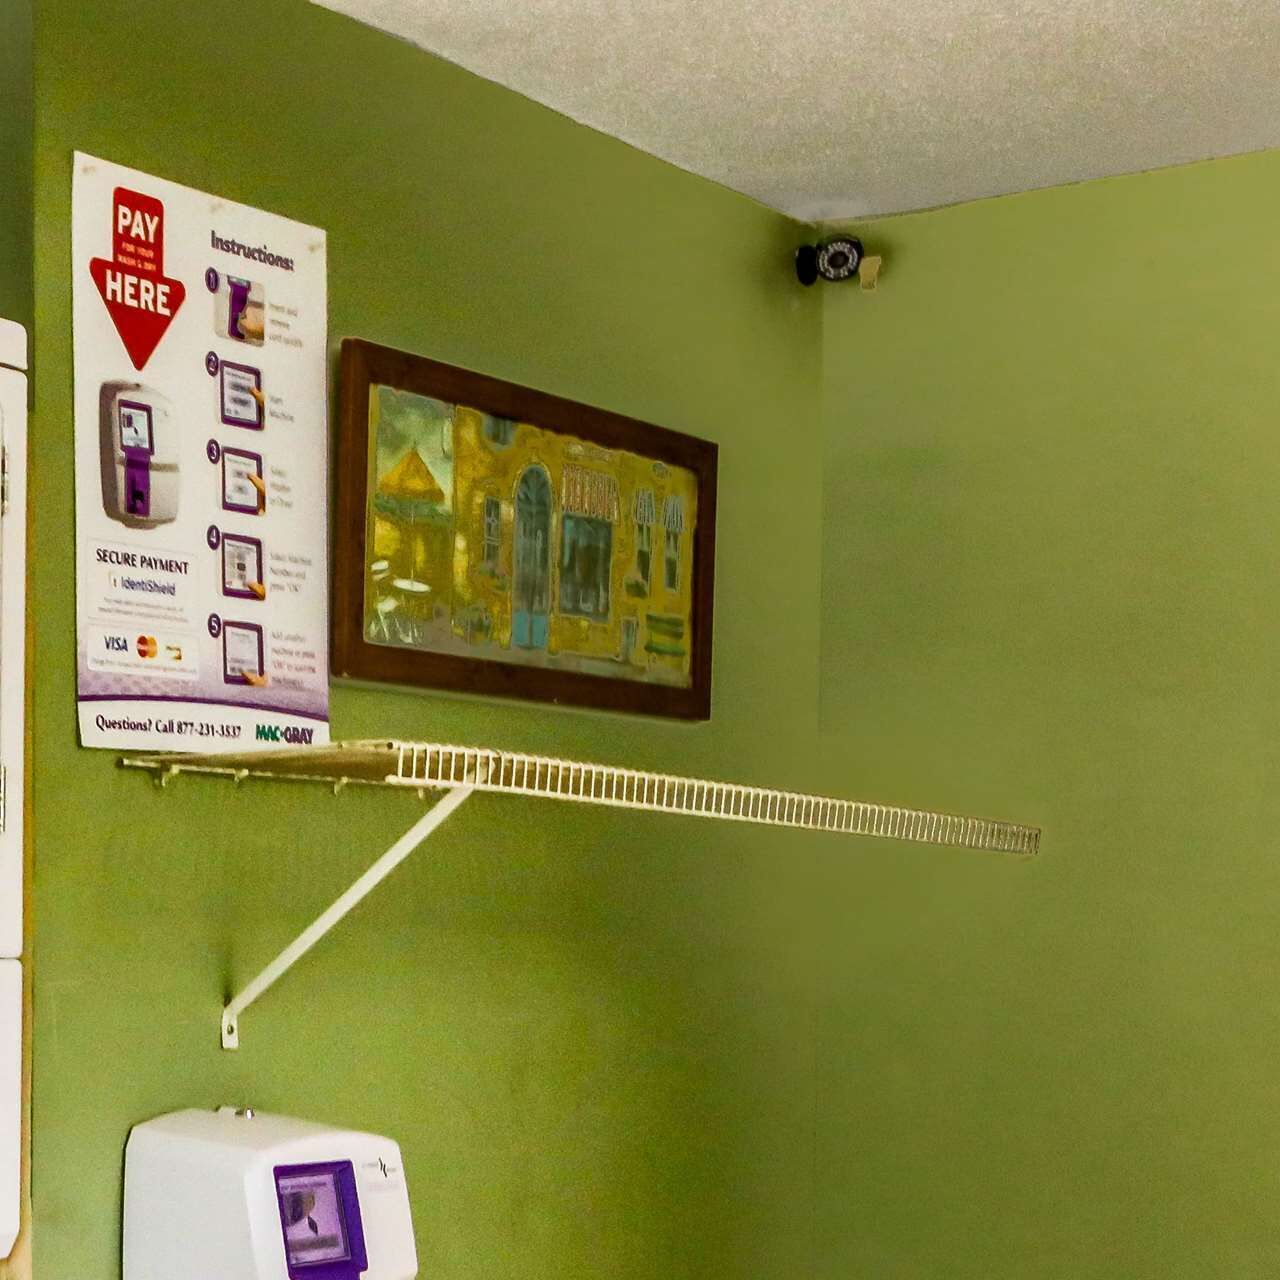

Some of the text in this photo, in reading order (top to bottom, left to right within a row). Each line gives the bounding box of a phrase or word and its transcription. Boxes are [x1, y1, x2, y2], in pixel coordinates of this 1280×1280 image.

[117, 204, 159, 243] PAY
[211, 229, 295, 272] Instructions:
[105, 268, 171, 317] HERE
[210, 443, 217, 460] 3
[210, 528, 216, 543] 4
[96, 548, 189, 575] SECURE PAYMENT
[211, 617, 218, 634] 5
[104, 636, 128, 652] VISA
[95, 714, 153, 732] Questions?
[155, 719, 174, 733] Call
[177, 720, 241, 738] 877-231-3537
